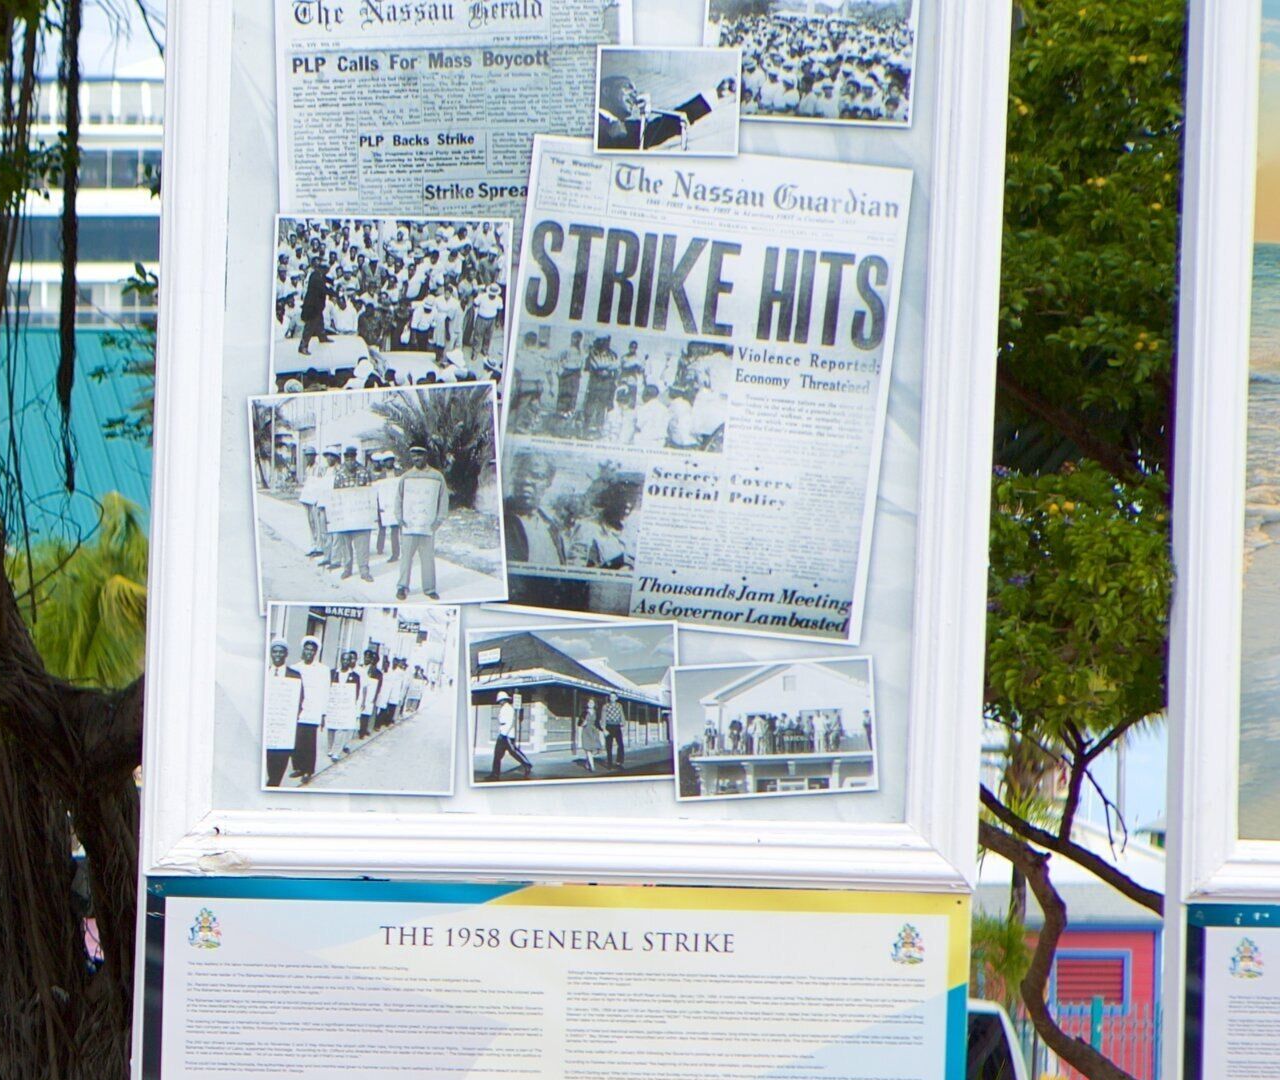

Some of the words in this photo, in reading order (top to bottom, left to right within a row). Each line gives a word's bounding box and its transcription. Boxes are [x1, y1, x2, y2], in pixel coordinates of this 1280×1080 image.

[294, 0, 344, 31] The
[360, 0, 455, 30] Nassau
[468, 0, 543, 29] Herald
[292, 57, 326, 73] PLP
[338, 55, 379, 72] Calls
[390, 54, 418, 70] For
[428, 52, 472, 68] Mass
[483, 50, 550, 70] Boycott
[359, 135, 384, 148] PLP
[393, 134, 430, 147] Backs
[437, 133, 475, 146] Strike
[425, 183, 474, 200] Strike
[615, 163, 663, 194] The
[672, 170, 765, 208] Nassau
[773, 183, 899, 219] Guardian
[525, 220, 742, 337] STRIKE
[756, 246, 889, 351] HITS
[738, 347, 801, 366] Violence
[735, 368, 790, 389] Economy
[652, 466, 720, 487] Secrecy
[730, 473, 793, 490] Covers
[648, 484, 719, 502] Official
[728, 491, 785, 511] Policy
[639, 576, 735, 600] Thousands
[734, 585, 774, 604] Jam
[777, 588, 853, 615] Meeting
[324, 606, 364, 619] BAKERY
[633, 598, 656, 615] As
[658, 599, 744, 623] Governor
[745, 608, 849, 633] Lambasted
[380, 925, 434, 947] THE
[445, 927, 501, 949] 1958
[509, 928, 634, 951] GENERAL
[642, 931, 735, 953] STRIKE
